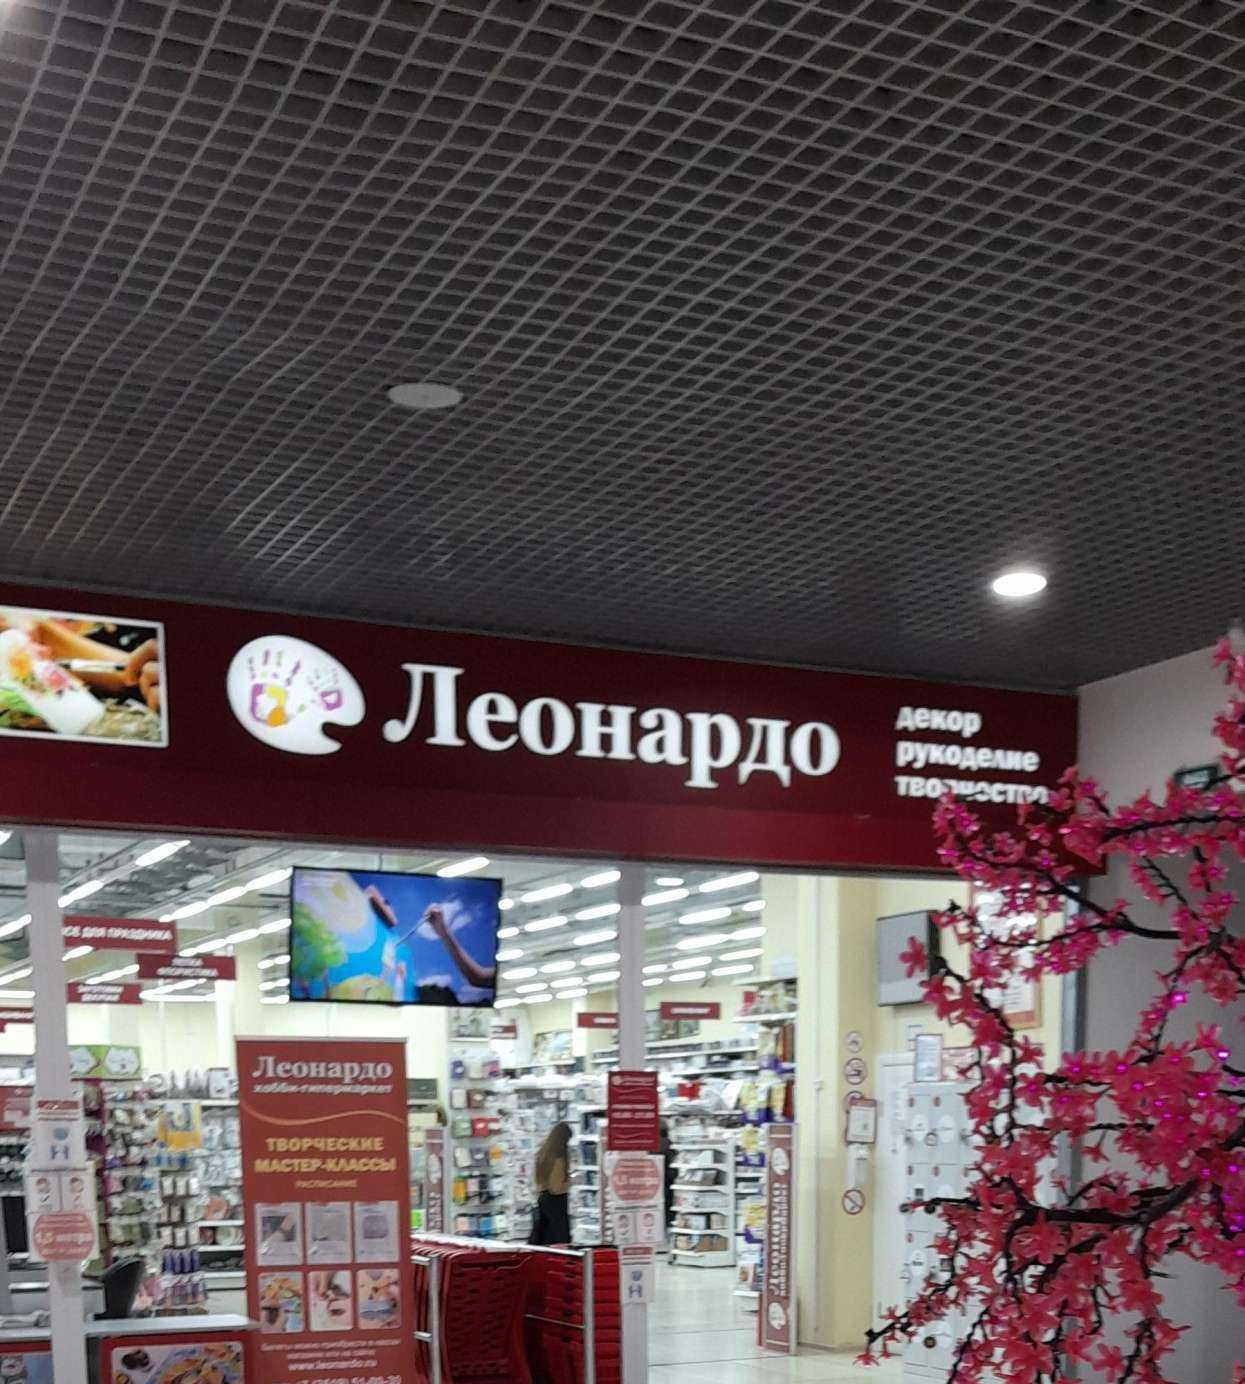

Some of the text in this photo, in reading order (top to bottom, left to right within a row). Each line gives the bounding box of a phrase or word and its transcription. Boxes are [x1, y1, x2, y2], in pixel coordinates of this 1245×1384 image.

[382, 662, 840, 789] Леонардо
[895, 705, 982, 738] декор
[895, 740, 1040, 772] рукоделие
[252, 1056, 393, 1084] Леонардо
[265, 1137, 385, 1151] ТВОРЧЕСКИЕ
[254, 1157, 397, 1173] МАСТЕР-КЛАССЫ
[288, 1359, 378, 1371] www.leonardo.ru
